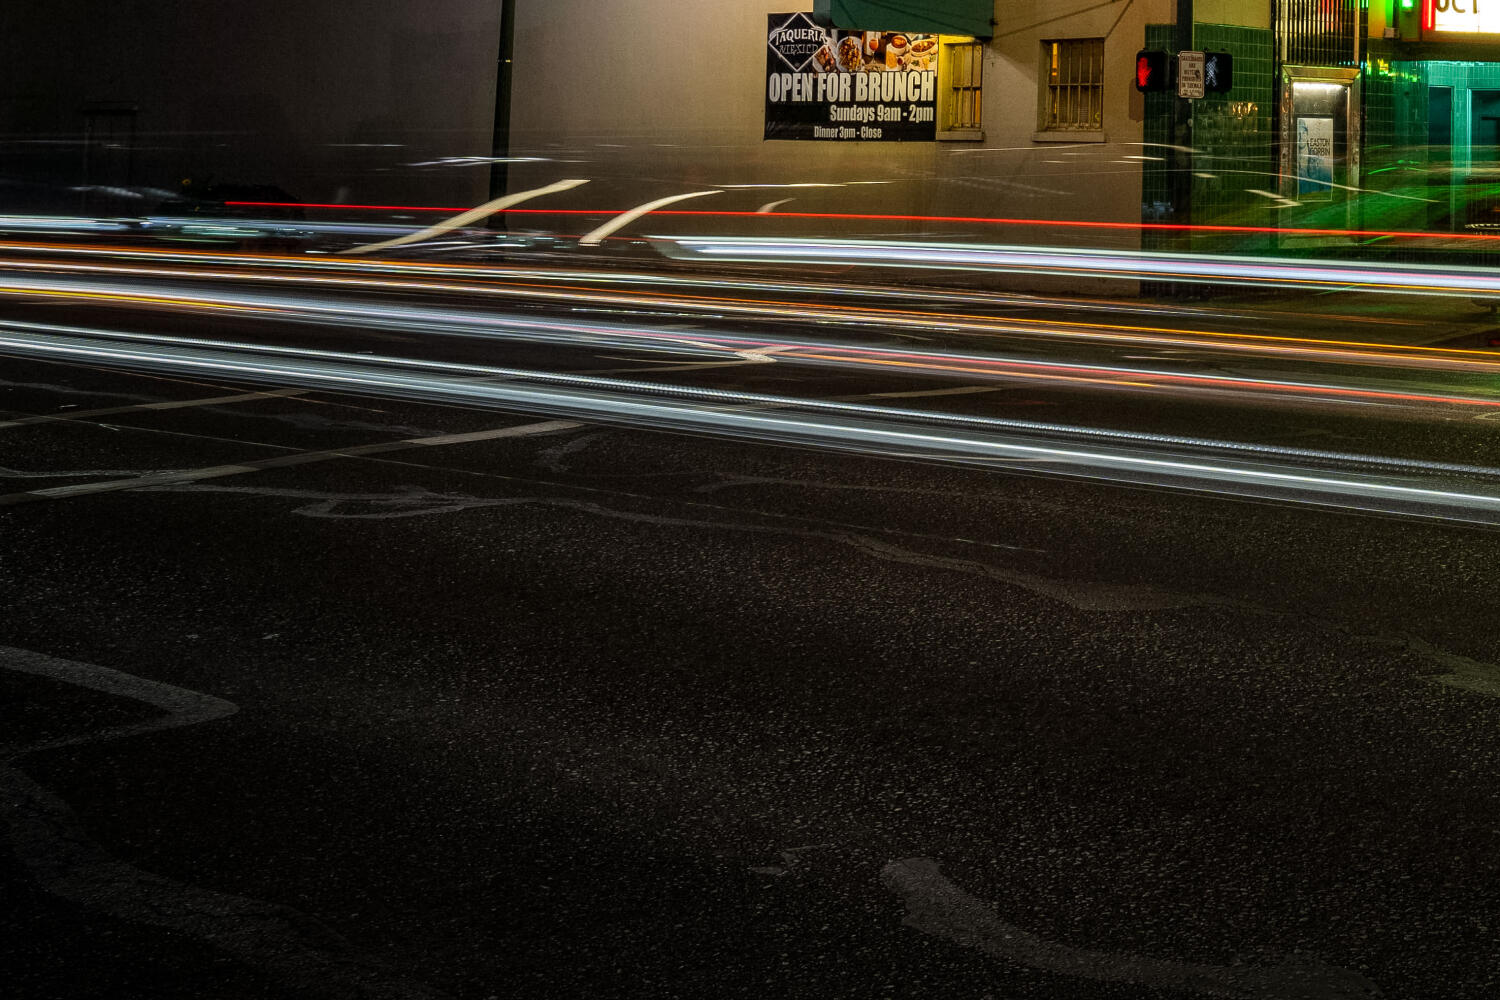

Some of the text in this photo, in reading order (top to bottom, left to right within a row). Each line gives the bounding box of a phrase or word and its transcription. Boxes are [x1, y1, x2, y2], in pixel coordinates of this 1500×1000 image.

[771, 27, 828, 44] TAQUERIA
[769, 71, 934, 103] OPEN FOR BRUNCH
[830, 104, 875, 123] Sundays
[877, 105, 901, 121] 9am
[909, 105, 934, 123] 2pm
[814, 126, 838, 139] Dinner
[839, 127, 856, 140] 3pm
[861, 126, 882, 139] Close
